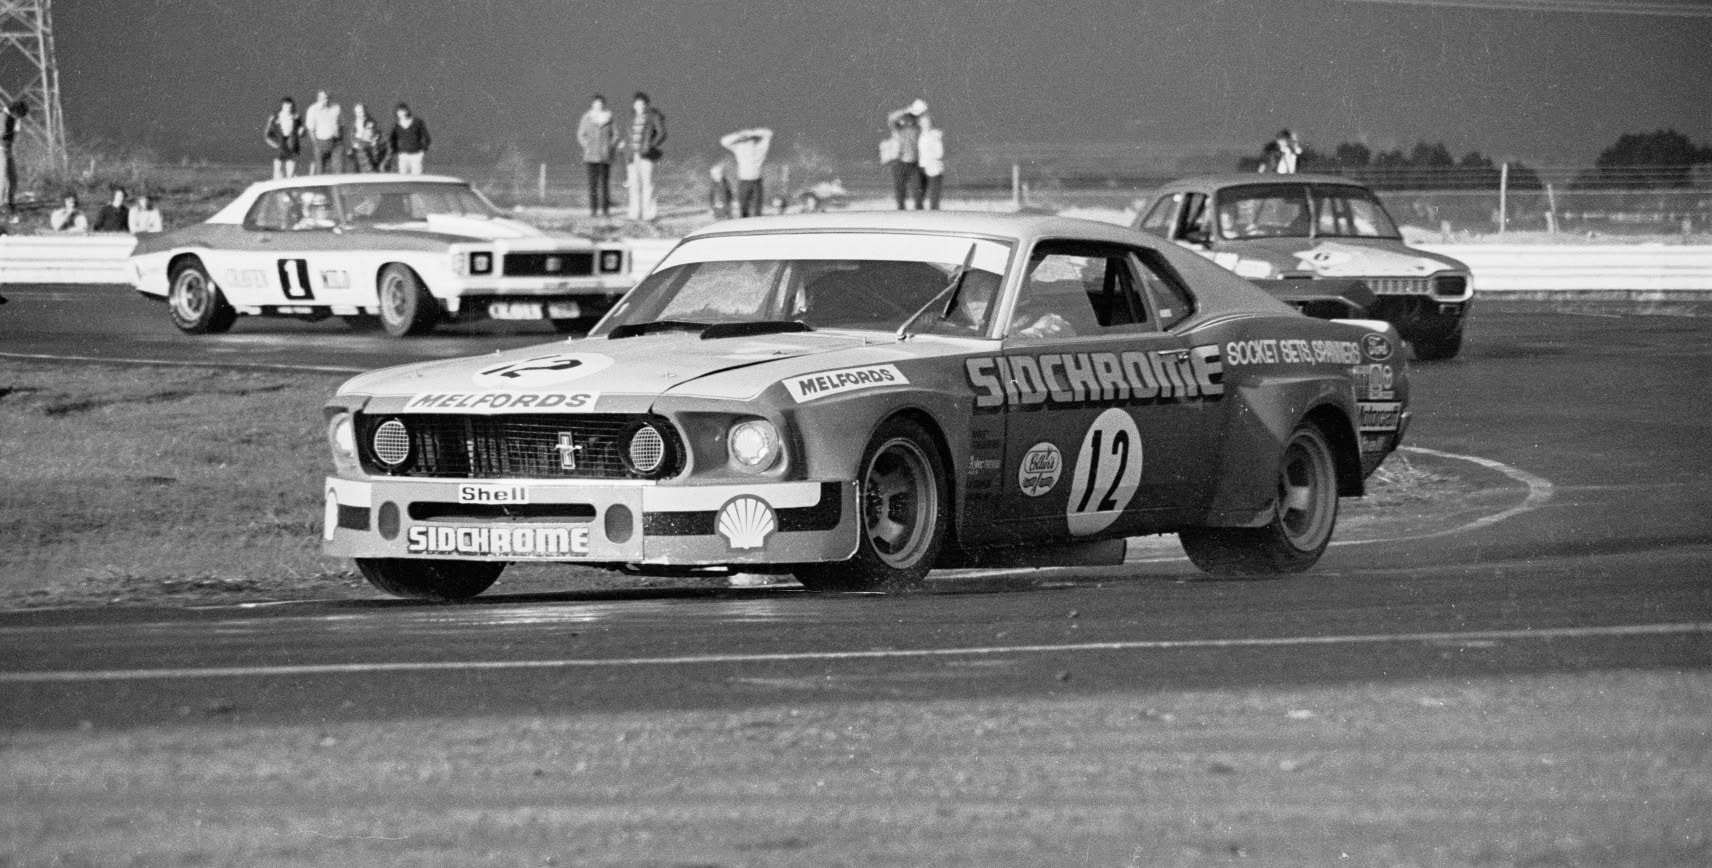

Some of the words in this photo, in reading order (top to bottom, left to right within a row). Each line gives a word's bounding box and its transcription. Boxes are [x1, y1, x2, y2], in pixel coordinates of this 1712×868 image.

[282, 259, 307, 297] 1
[1226, 339, 1279, 366] SOCKET
[1279, 339, 1315, 366] SETS,
[1311, 340, 1362, 365] SPANNERS
[1367, 336, 1388, 355] Ford
[481, 354, 584, 379] 12
[964, 343, 1225, 411] SIDCHROME
[798, 367, 897, 397] MELFORDS
[410, 393, 593, 408] MELFORDS
[1076, 429, 1129, 513] 12
[461, 486, 526, 501] Shell
[407, 526, 591, 557] SIDCHROME
